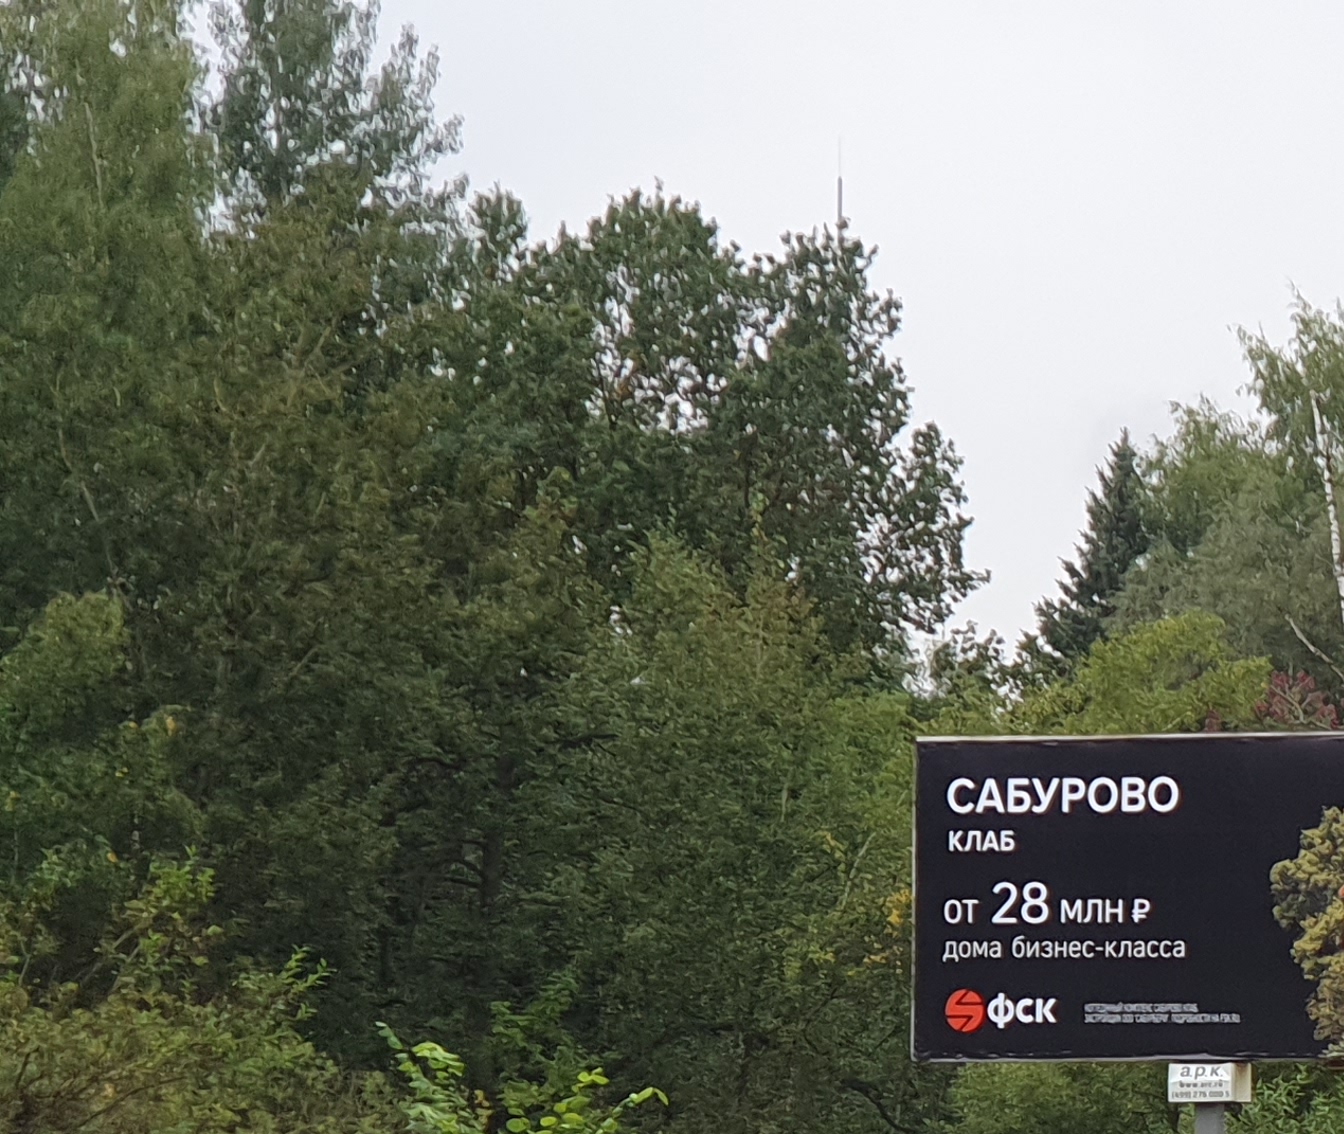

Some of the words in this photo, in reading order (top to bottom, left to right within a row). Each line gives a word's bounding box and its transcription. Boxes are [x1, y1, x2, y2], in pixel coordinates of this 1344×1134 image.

[946, 775, 1180, 815] САБУРОВО
[948, 829, 1016, 852] КЛАБ
[991, 880, 1050, 925] 28
[942, 939, 1002, 962] дома
[1011, 935, 1187, 959] бизнес-класса
